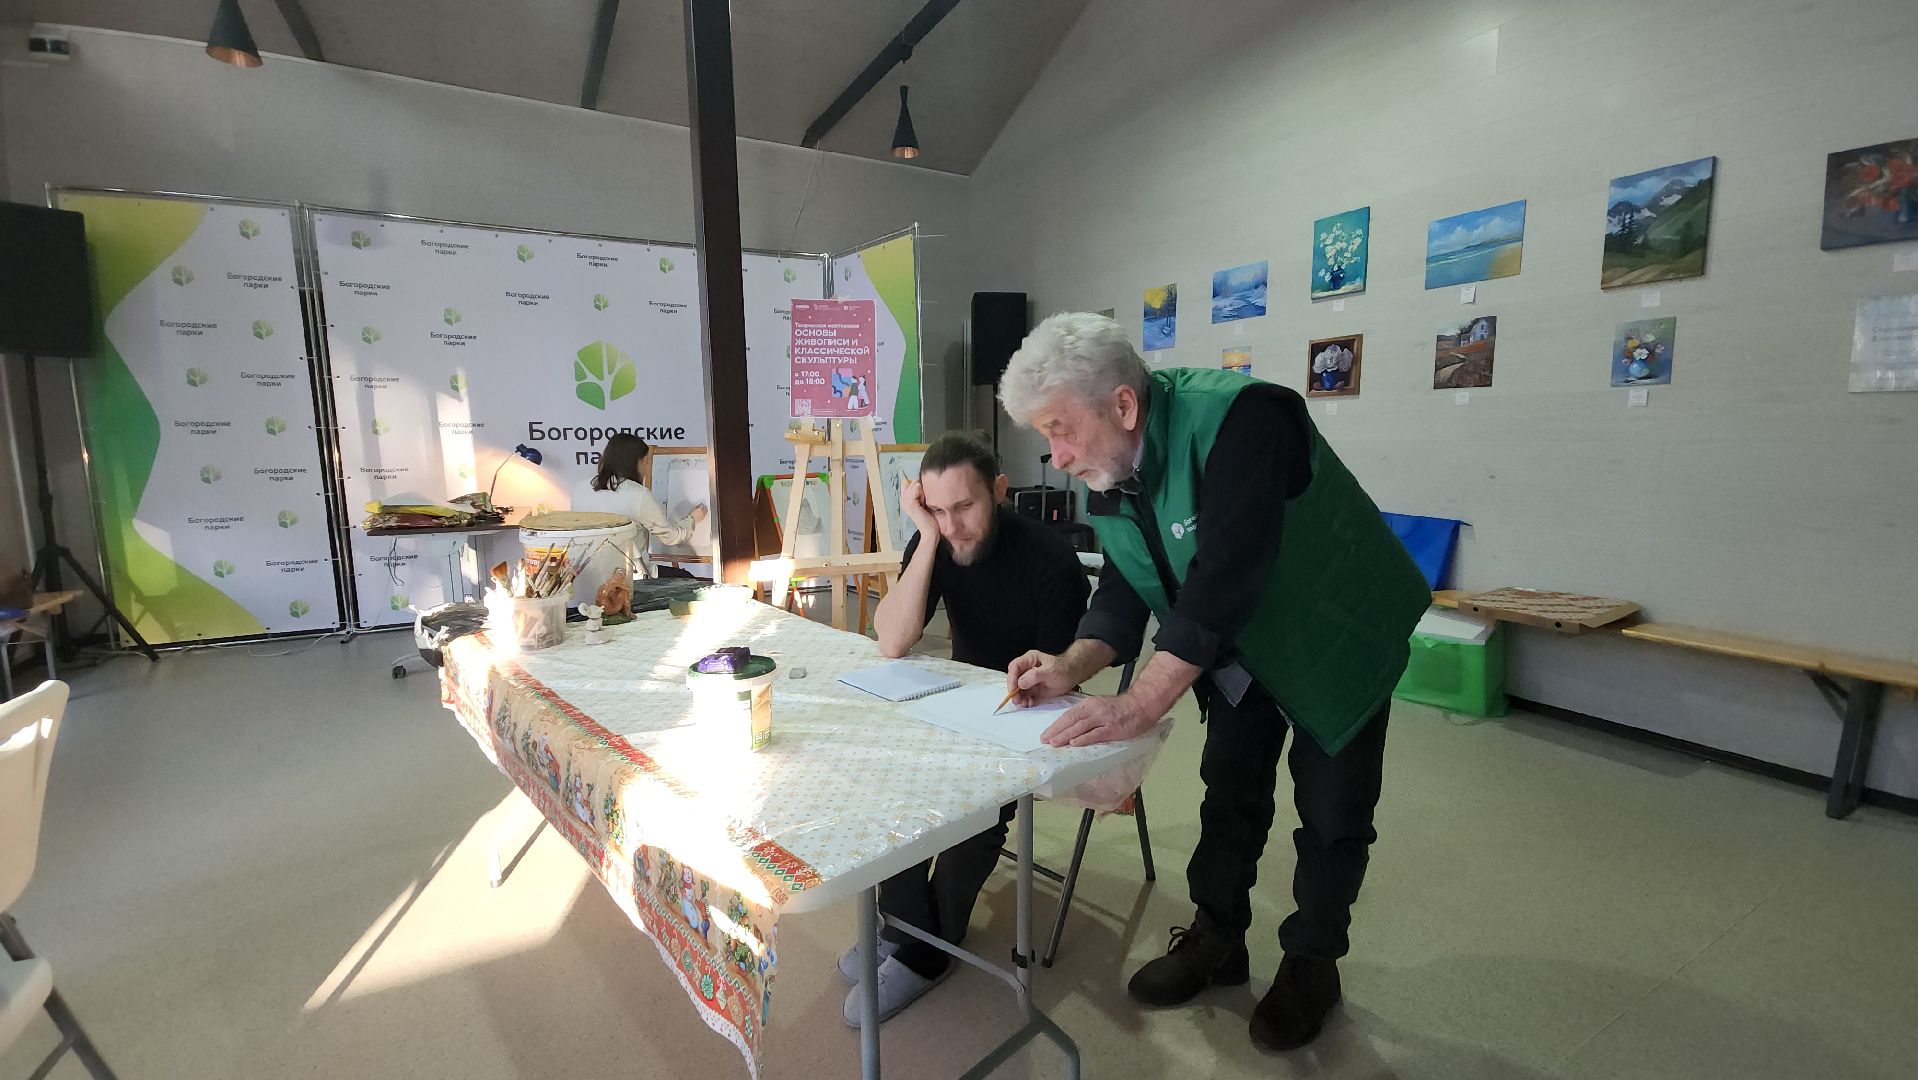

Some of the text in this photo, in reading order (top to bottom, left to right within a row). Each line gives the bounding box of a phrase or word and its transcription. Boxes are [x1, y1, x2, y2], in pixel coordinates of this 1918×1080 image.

[421, 239, 469, 251] Богородские
[435, 248, 458, 256] парки
[227, 272, 283, 284] Богородские
[243, 280, 270, 289] парки
[339, 280, 390, 291] Богородские
[353, 289, 378, 298] парки
[505, 290, 550, 302] Богородские
[518, 299, 539, 307] парки
[159, 319, 217, 331] Богородские
[176, 328, 204, 336] парки
[794, 329, 837, 337] ОСНОВЫ
[430, 332, 477, 342] Богородские
[443, 339, 466, 347] парки
[794, 338, 859, 346] ЖИВОПИСИ И
[794, 345, 870, 355] КЛАССИЧЕСКОЙ
[794, 356, 858, 365] СКУЛЬПТУРЫ
[240, 372, 295, 383] Богородские
[801, 370, 820, 378] 17:00
[255, 378, 283, 388] парки
[805, 378, 826, 386] 18:00
[174, 420, 231, 431] Богородские
[189, 427, 217, 436] парки
[254, 467, 307, 478] Богородские
[268, 473, 295, 482] парки
[187, 517, 244, 527] Богородские
[203, 522, 232, 531] парки
[265, 558, 319, 570] Богородские
[280, 565, 306, 574] парки
